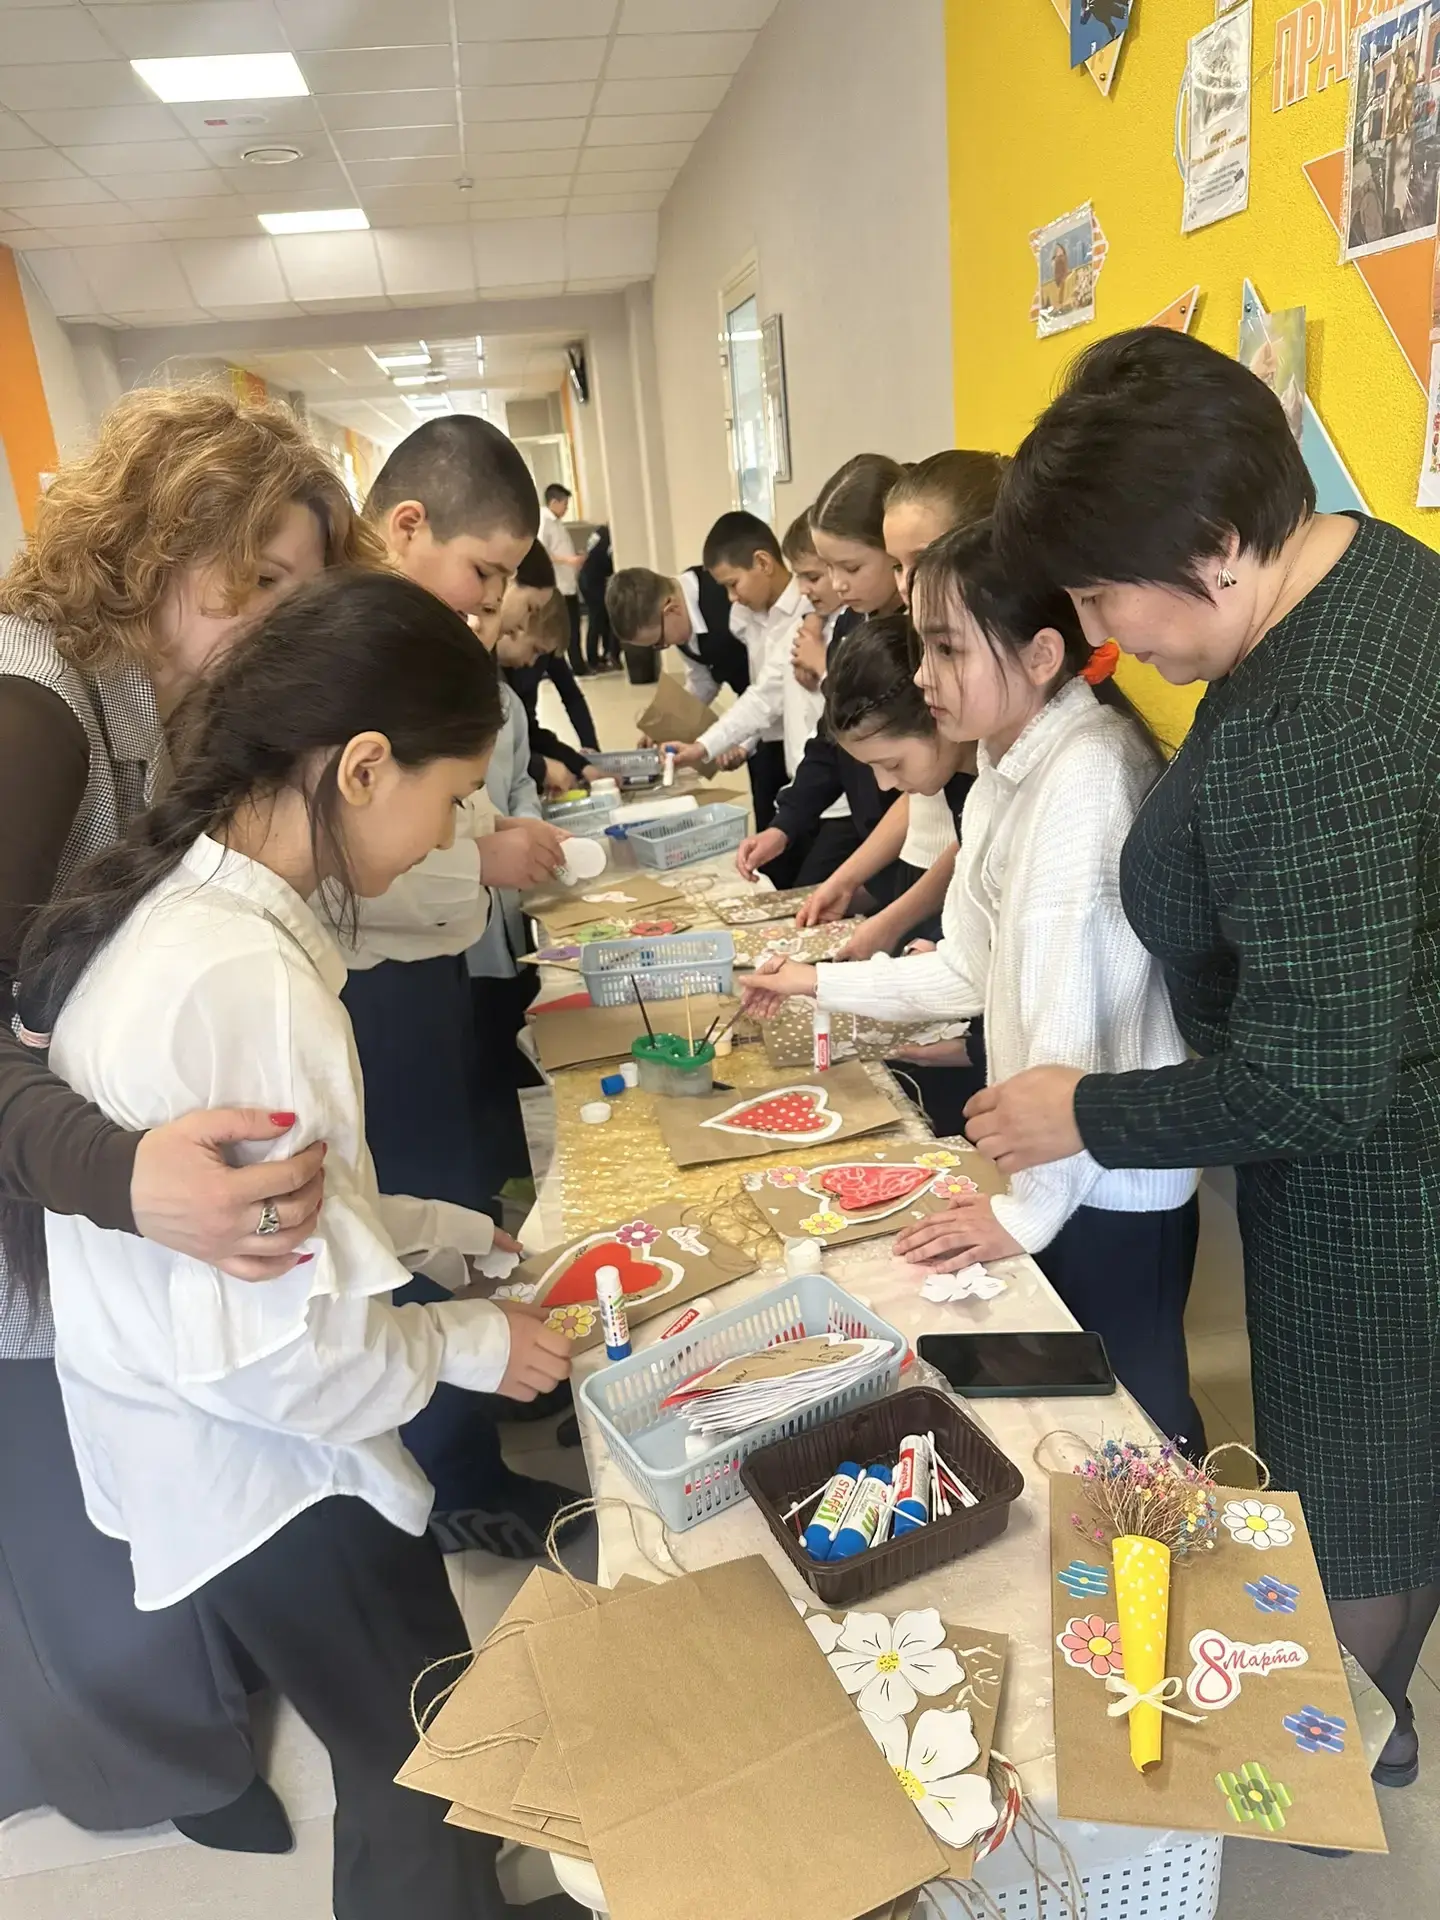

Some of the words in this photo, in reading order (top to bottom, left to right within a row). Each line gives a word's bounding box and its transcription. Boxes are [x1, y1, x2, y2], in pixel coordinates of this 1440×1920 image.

[827, 1479, 850, 1513] STAFF
[1195, 1638, 1232, 1704] 8
[1223, 1648, 1301, 1671] Марта
